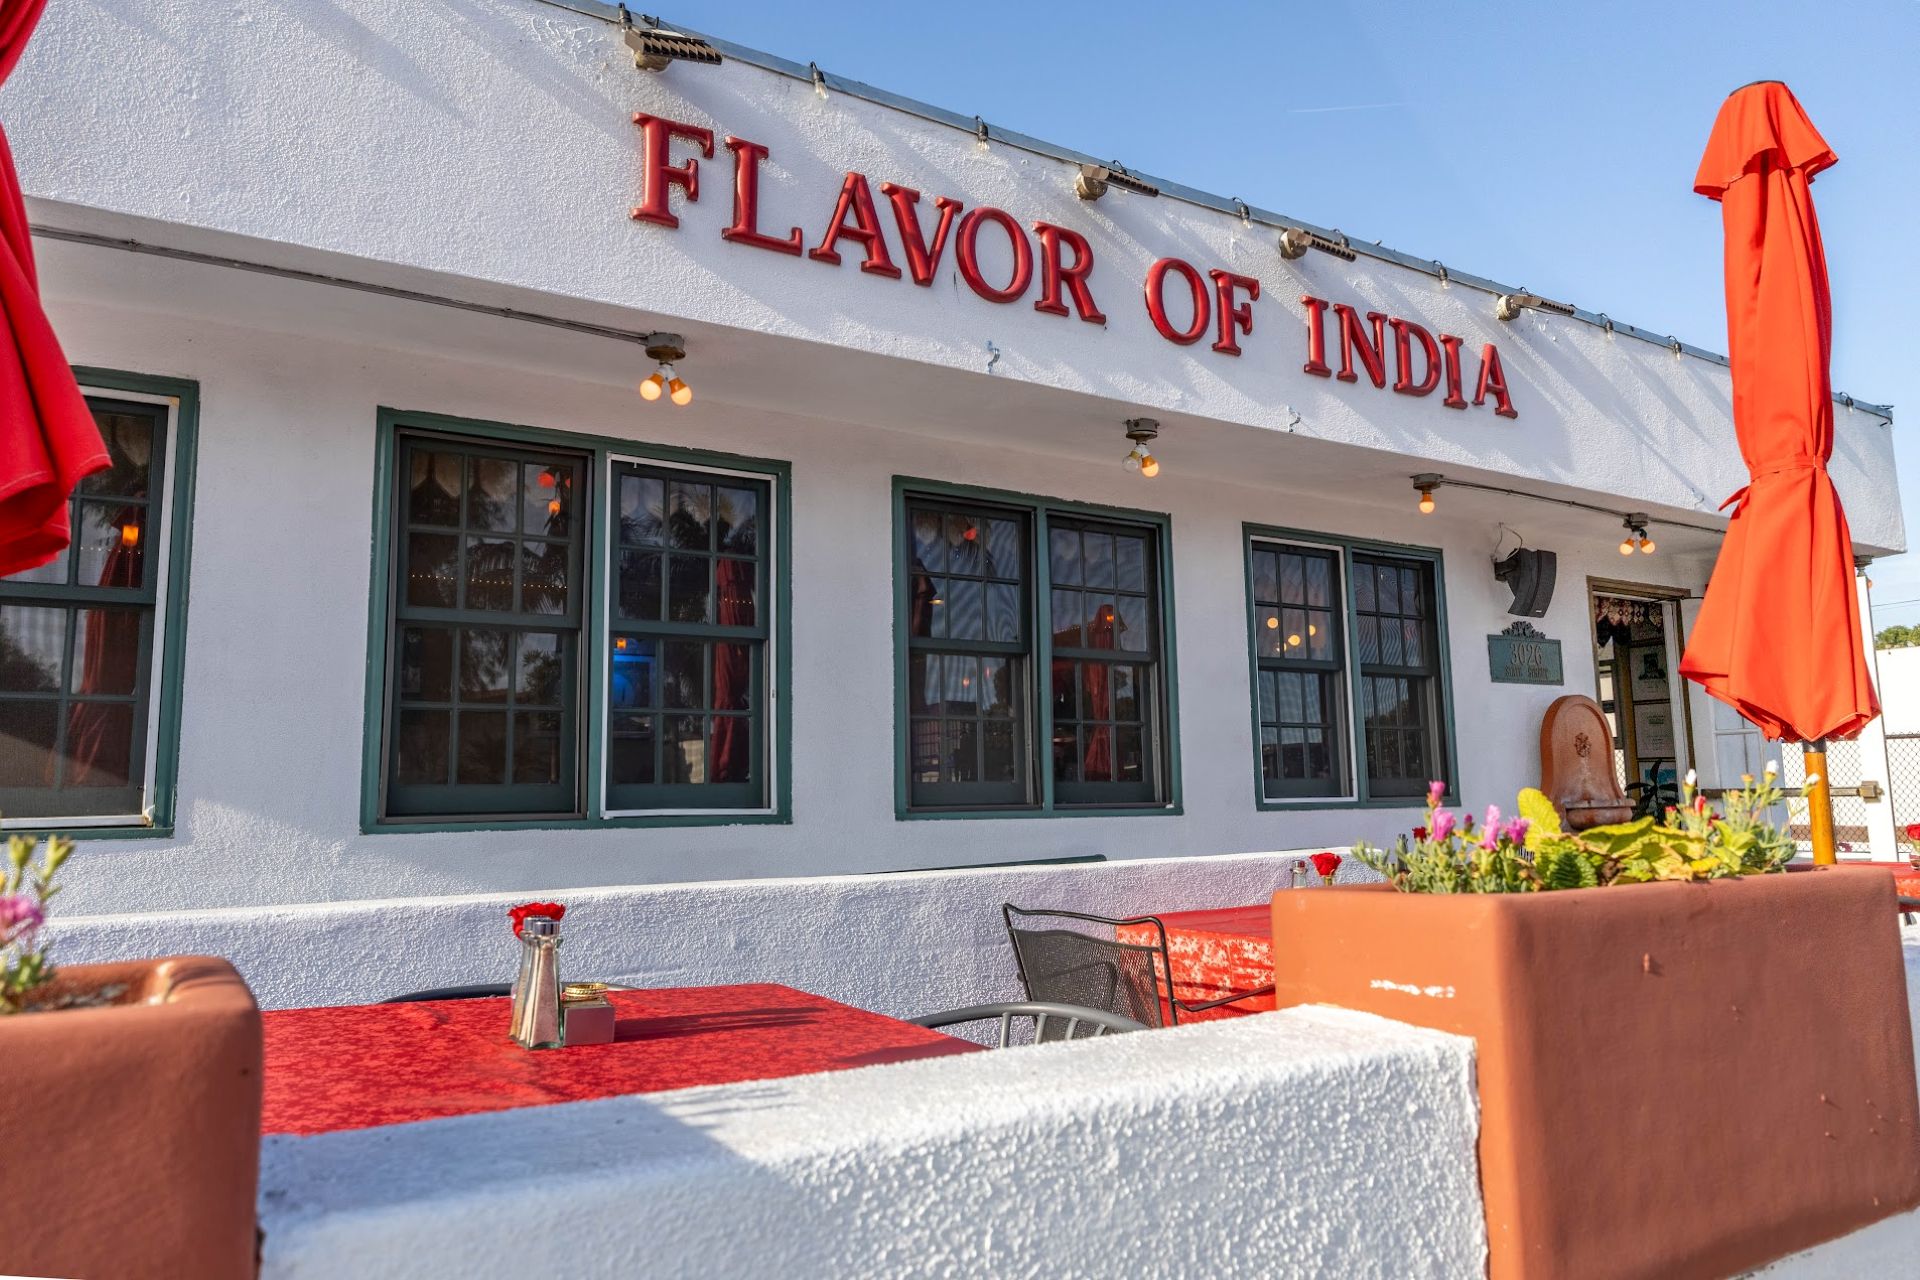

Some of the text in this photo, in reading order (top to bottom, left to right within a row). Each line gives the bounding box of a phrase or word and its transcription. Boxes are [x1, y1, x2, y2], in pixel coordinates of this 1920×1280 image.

[630, 111, 1519, 419] FLAVOR OF INDIA
[1510, 642, 1542, 666] 3026
